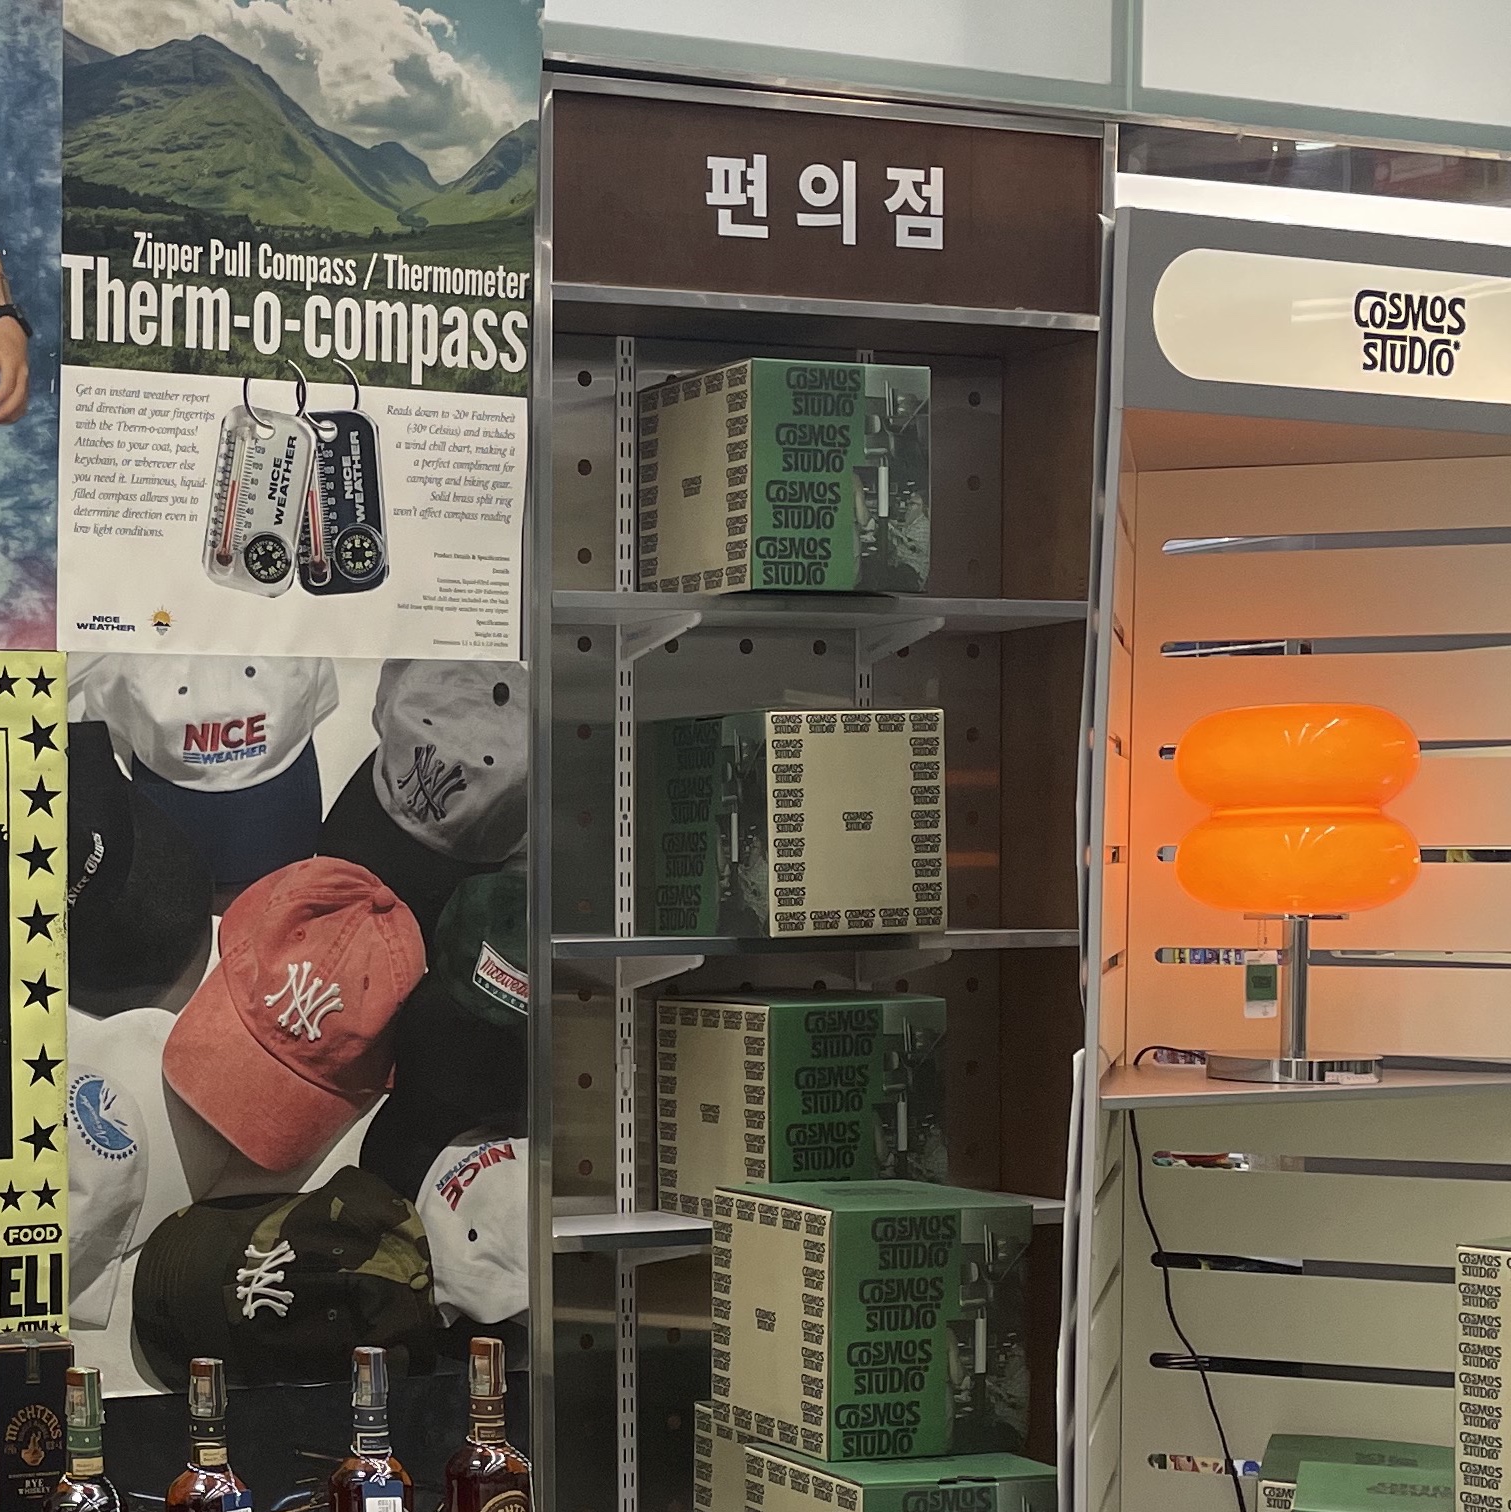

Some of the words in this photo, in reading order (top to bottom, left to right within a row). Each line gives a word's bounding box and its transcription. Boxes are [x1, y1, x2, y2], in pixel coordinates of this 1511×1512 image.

[705, 153, 944, 250] 편의점
[132, 231, 203, 278] Zipper
[209, 238, 251, 278] Pull
[257, 242, 357, 290] Compass
[383, 252, 531, 300] Thermometer
[60, 253, 529, 386] Therm-o-compass
[1354, 288, 1466, 336] COSMOS
[1362, 331, 1460, 377] STUDIO
[75, 383, 92, 398] Get
[94, 387, 106, 396] an
[109, 386, 141, 399] instant
[143, 389, 180, 401] weather
[182, 392, 210, 404] report
[75, 401, 93, 412] and
[96, 402, 135, 415] direction
[138, 406, 147, 416] at
[149, 409, 170, 420] your
[171, 407, 215, 423] fingertips
[75, 418, 97, 430] with
[99, 420, 113, 431] the
[74, 436, 114, 449] Attaches
[117, 438, 125, 448] to
[127, 441, 149, 453] your
[776, 422, 851, 448] COSMOS
[74, 453, 118, 468] keychain,
[122, 457, 131, 466] or
[134, 456, 177, 470] wherever
[179, 459, 196, 471] else
[781, 446, 848, 473] STUDIO
[72, 472, 91, 485] you
[93, 472, 116, 483] need
[268, 456, 283, 502] NICE
[273, 435, 297, 526] WEATHER
[342, 455, 355, 500] NICE
[349, 430, 366, 523] WEATHER
[765, 479, 841, 504] COSMOS
[772, 503, 839, 530] STUDIO
[755, 535, 832, 561] COSMOS
[762, 560, 829, 586] STUDIO
[76, 622, 136, 632] WEATHER
[92, 615, 120, 624] NICE
[182, 712, 267, 753] NICE
[200, 744, 267, 765] WEATHER
[440, 1143, 517, 1212] NICE
[8, 1226, 58, 1243] FOOD
[846, 1338, 933, 1368] COSMOS
[854, 1364, 930, 1396] STUDIO
[835, 1400, 921, 1430] COSMOS
[842, 1427, 918, 1459] STUDIO
